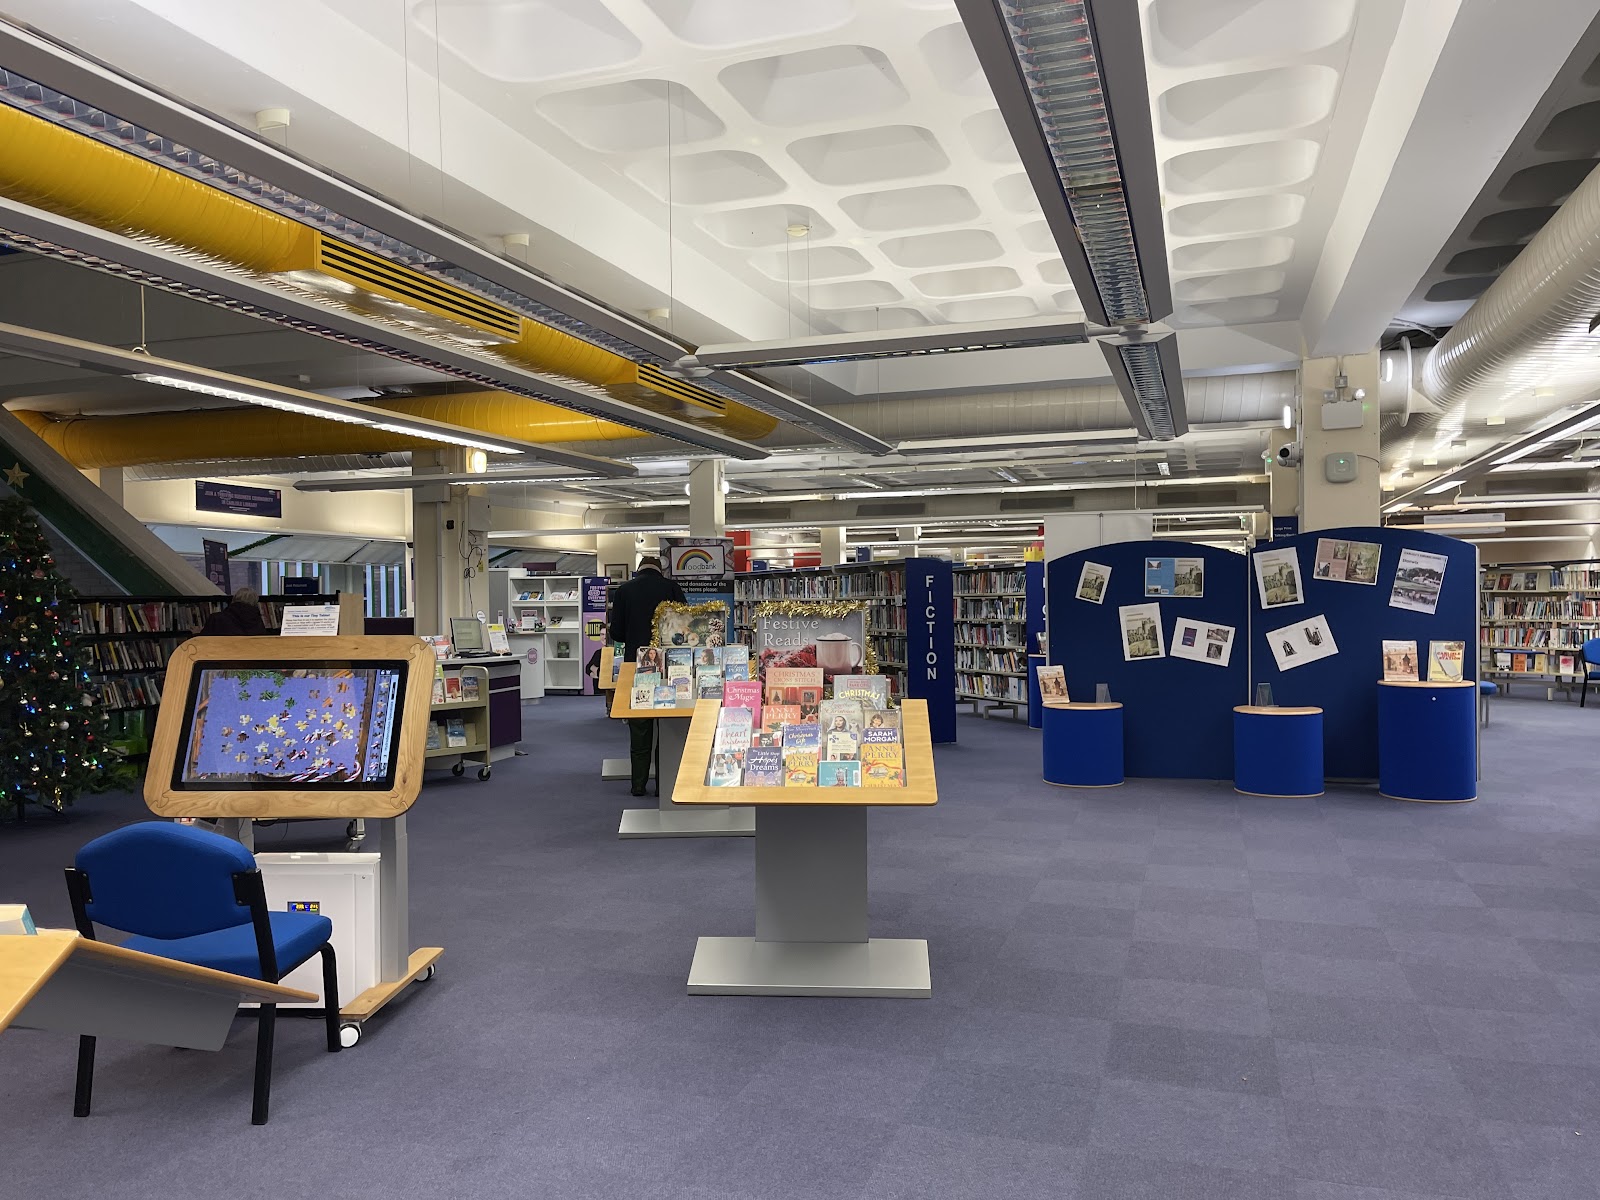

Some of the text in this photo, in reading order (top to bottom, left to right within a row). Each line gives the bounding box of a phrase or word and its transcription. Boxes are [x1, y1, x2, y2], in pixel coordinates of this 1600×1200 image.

[763, 617, 819, 630] Festive
[925, 575, 937, 680] FICTION
[763, 632, 809, 646] Reads
[728, 693, 755, 702] Magic
[838, 689, 880, 700] CHRISTMAS
[748, 757, 778, 765] Hopes
